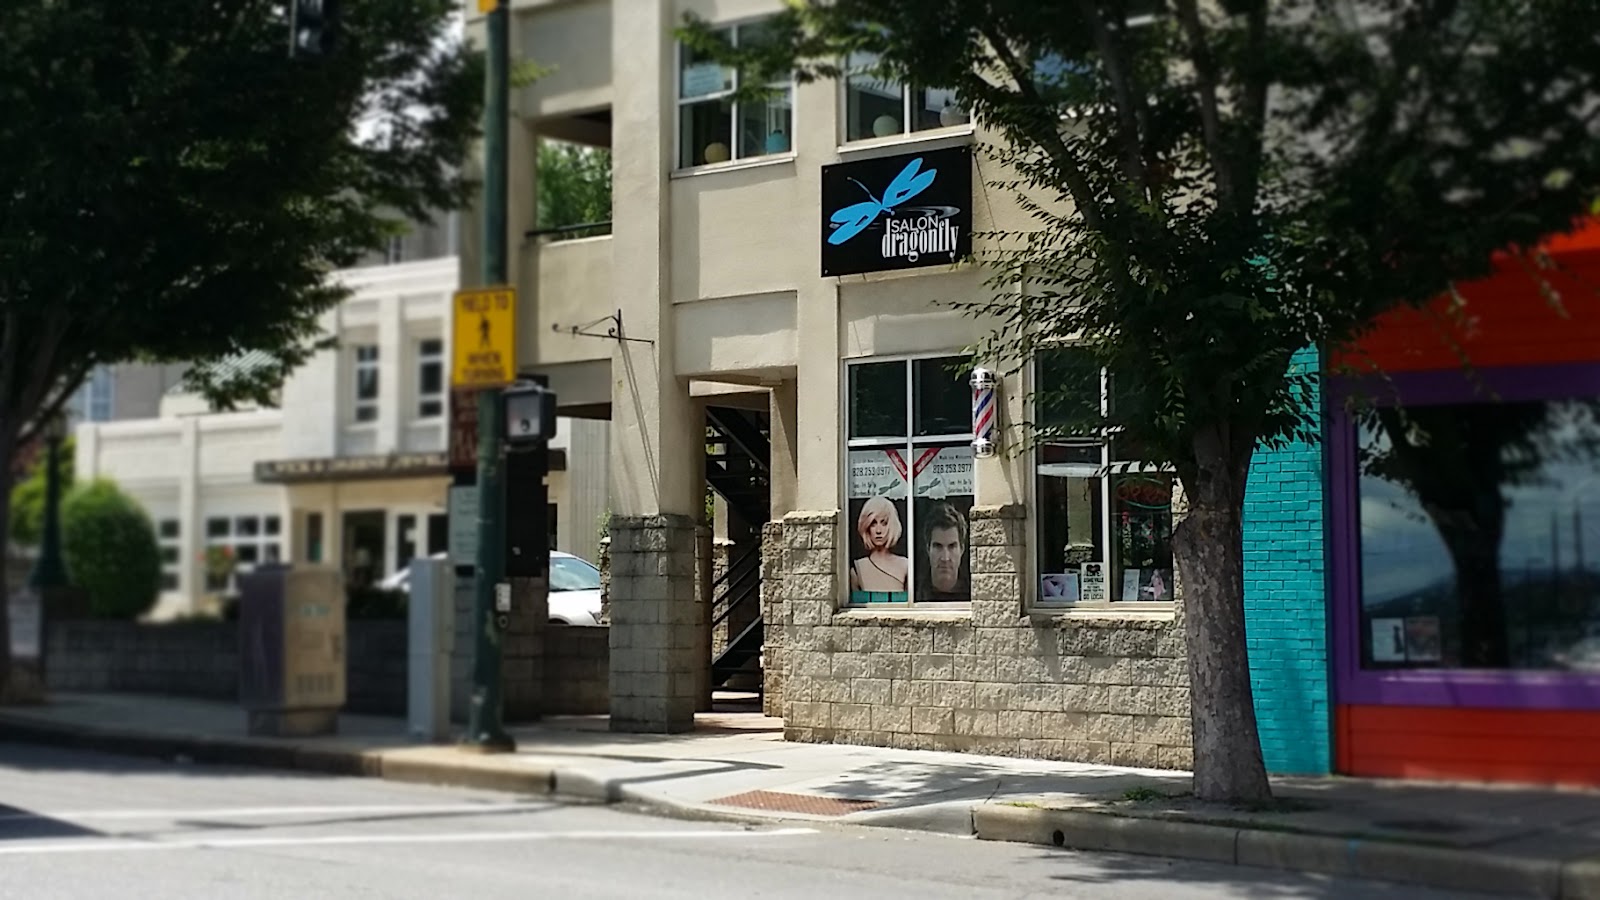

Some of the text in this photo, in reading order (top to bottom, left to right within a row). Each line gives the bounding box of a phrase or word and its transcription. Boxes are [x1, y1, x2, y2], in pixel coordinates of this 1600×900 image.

[891, 215, 939, 233] SALON
[881, 217, 960, 262] dragonfly
[461, 293, 509, 312] YIELD TO
[467, 352, 501, 364] WHEN
